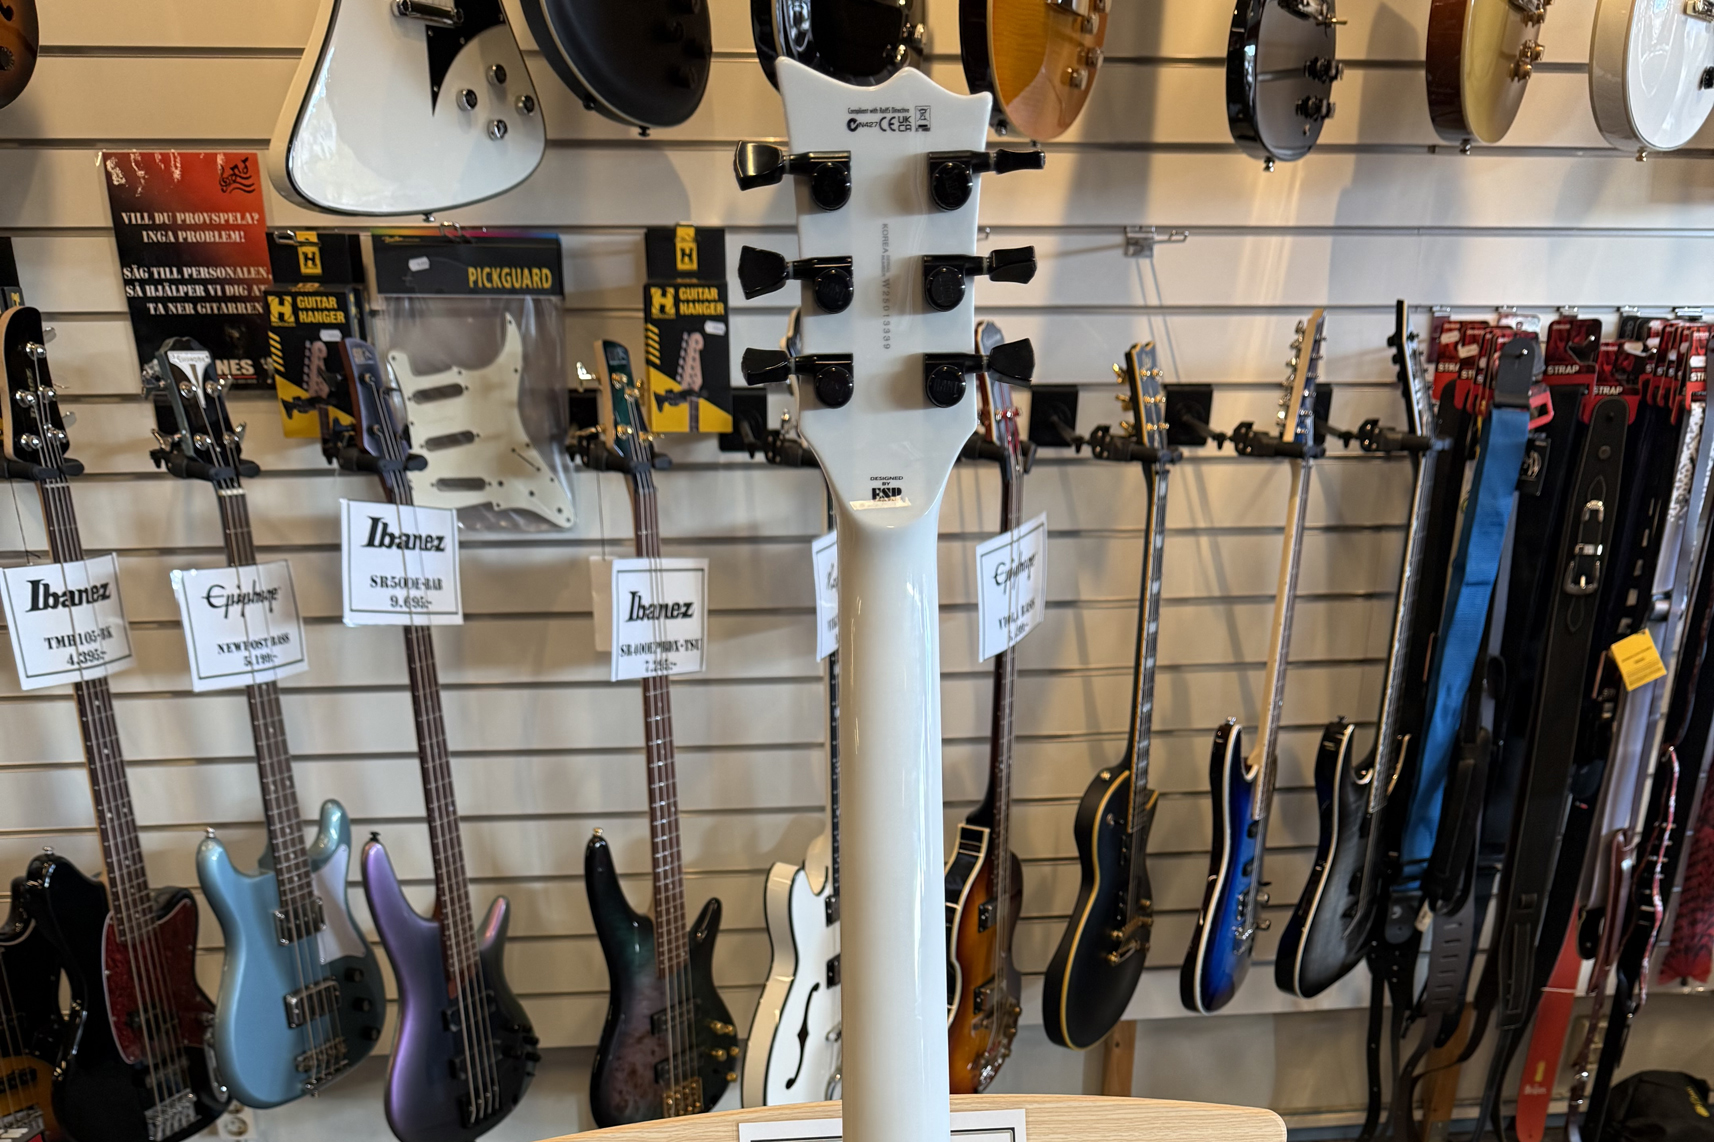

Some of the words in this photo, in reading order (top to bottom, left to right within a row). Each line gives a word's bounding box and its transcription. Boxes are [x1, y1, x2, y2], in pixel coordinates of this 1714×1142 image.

[121, 212, 152, 224] VILL
[155, 212, 173, 224] DU
[177, 212, 260, 224] PROVSPELA?
[142, 231, 175, 242] INGA
[178, 230, 246, 242] PROBLEM!
[151, 267, 181, 280] TILL
[468, 267, 552, 289] PICKGUARD
[146, 283, 205, 297] HJÄLPER
[208, 284, 222, 297] VI
[226, 284, 248, 297] DIG
[252, 284, 268, 296] AT
[679, 287, 718, 300] GUITAR
[147, 303, 166, 315] TA
[168, 303, 195, 315] NER
[197, 302, 264, 315] GITARREN
[296, 296, 338, 309] GUITAR
[679, 302, 724, 316] HANGER
[298, 310, 346, 324] HANGER
[1547, 364, 1580, 375] STRAP
[1594, 385, 1623, 396] STRAP
[361, 515, 446, 552] Ibanez
[25, 579, 112, 613] Ibanez
[201, 579, 280, 619] Epiphone
[625, 590, 695, 622] Ibanez
